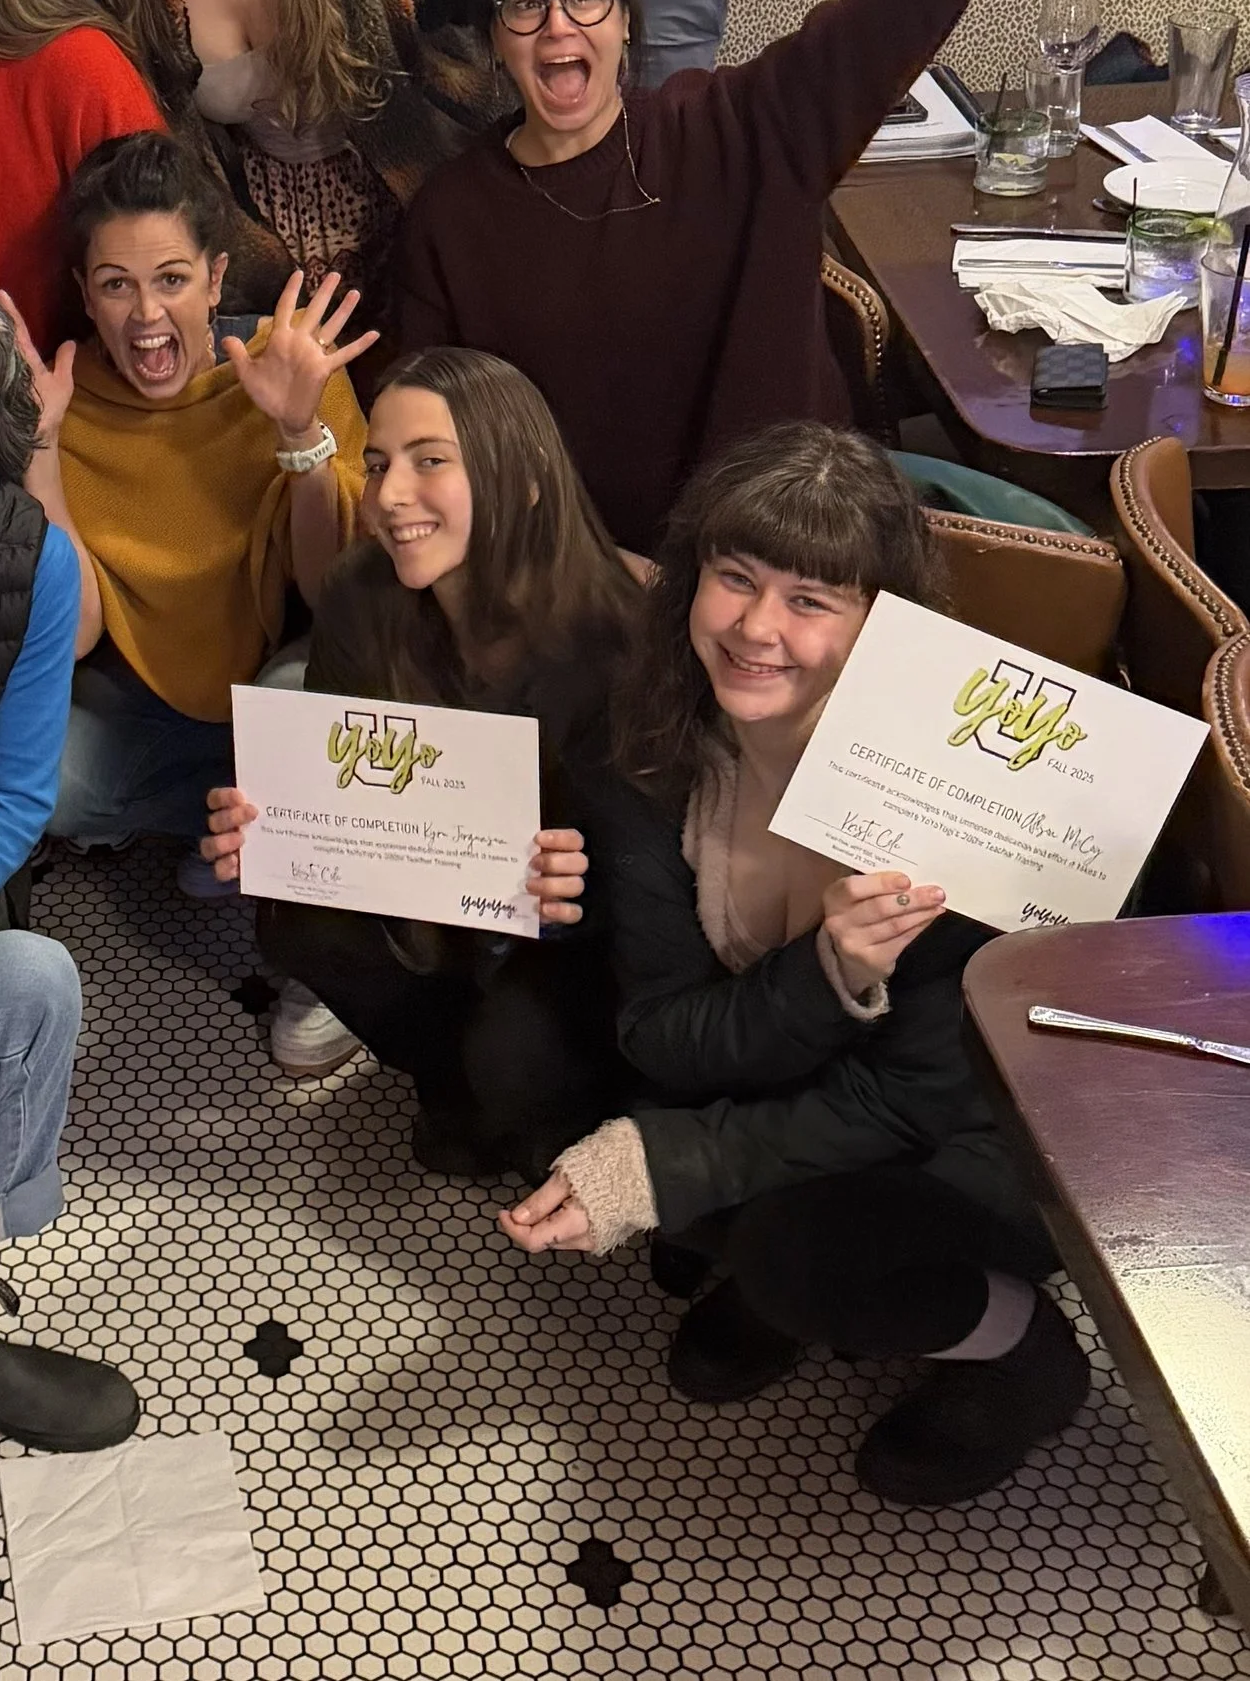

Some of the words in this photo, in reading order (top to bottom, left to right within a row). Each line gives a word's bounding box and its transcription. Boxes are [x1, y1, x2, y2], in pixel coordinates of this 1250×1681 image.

[947, 667, 1084, 772] YoYo
[327, 725, 442, 794] YoYo
[850, 743, 927, 784] CERTIFICATE
[928, 776, 947, 790] OF
[947, 785, 1022, 823] COMPLETION
[1047, 759, 1067, 773] FALL
[1070, 768, 1094, 783] 2025
[266, 806, 331, 825] CERTIFICATE
[335, 815, 348, 827] OF
[352, 818, 419, 834] COMPLETION
[1020, 902, 1068, 927] YoYoY
